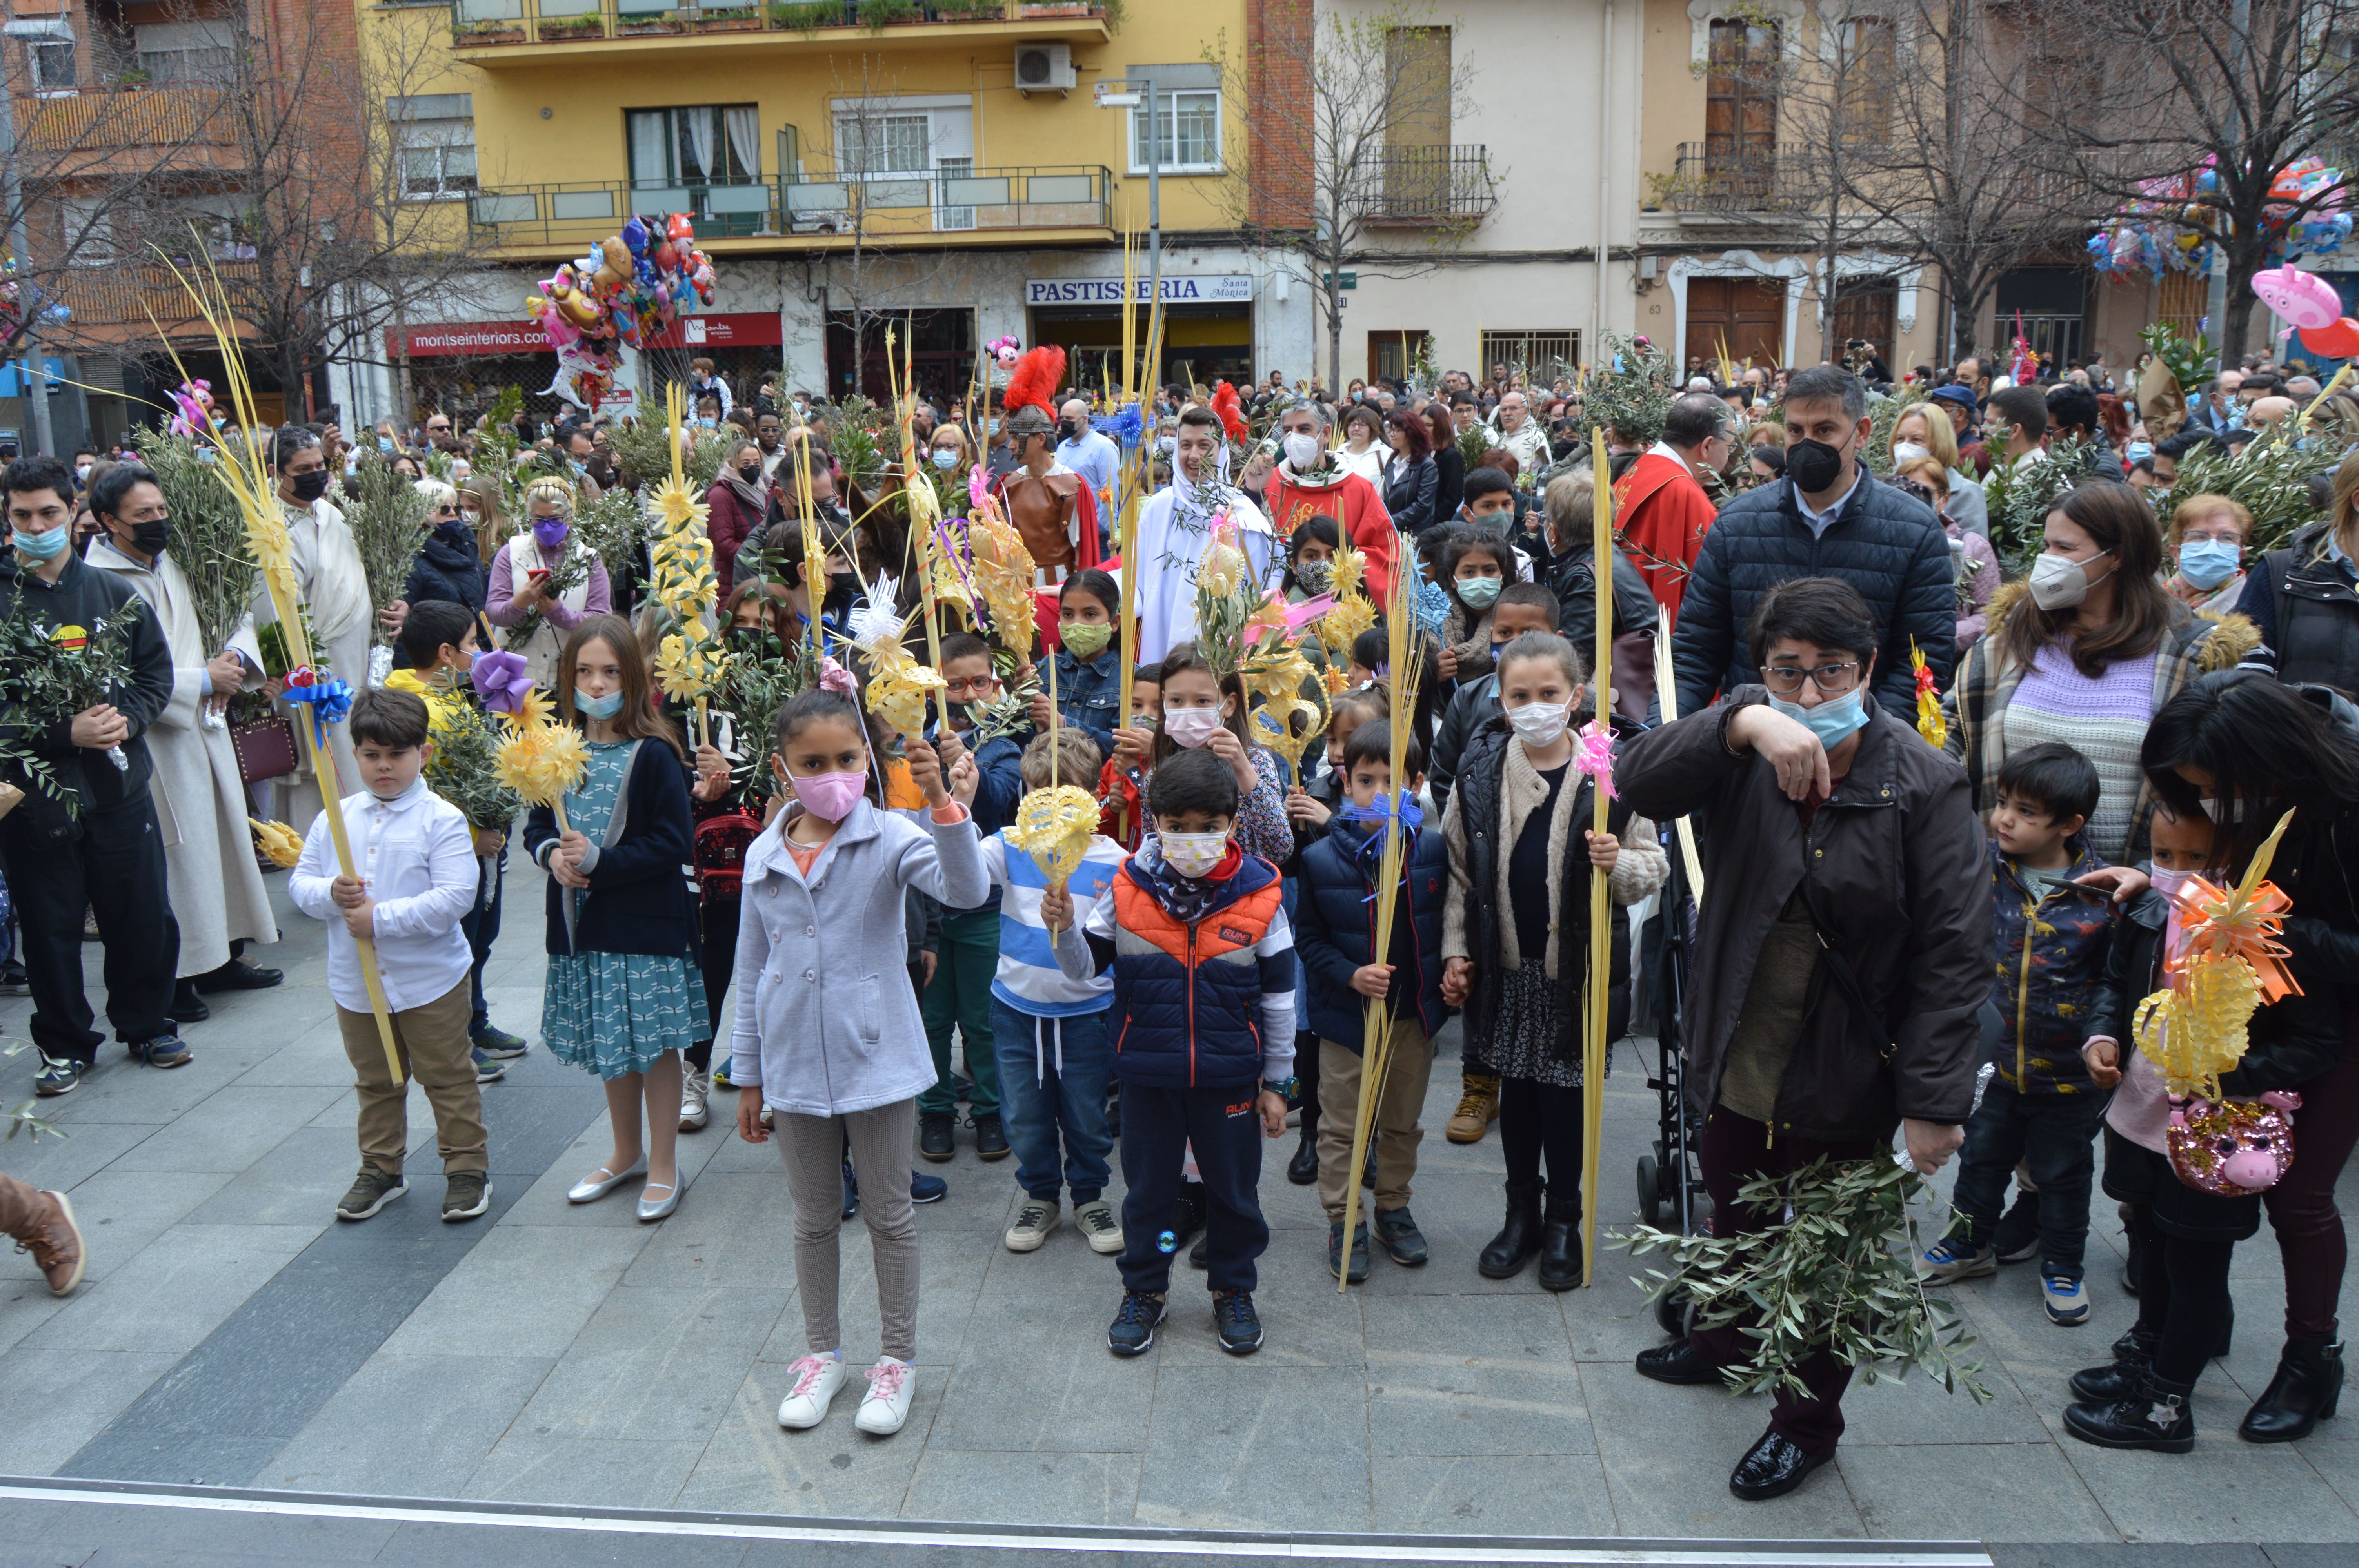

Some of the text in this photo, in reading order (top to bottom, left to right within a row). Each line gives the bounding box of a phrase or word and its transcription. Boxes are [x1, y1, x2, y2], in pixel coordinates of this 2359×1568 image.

[1222, 278, 1248, 287] Santa
[1210, 288, 1248, 298] Mònica
[1649, 305, 1661, 314] 63
